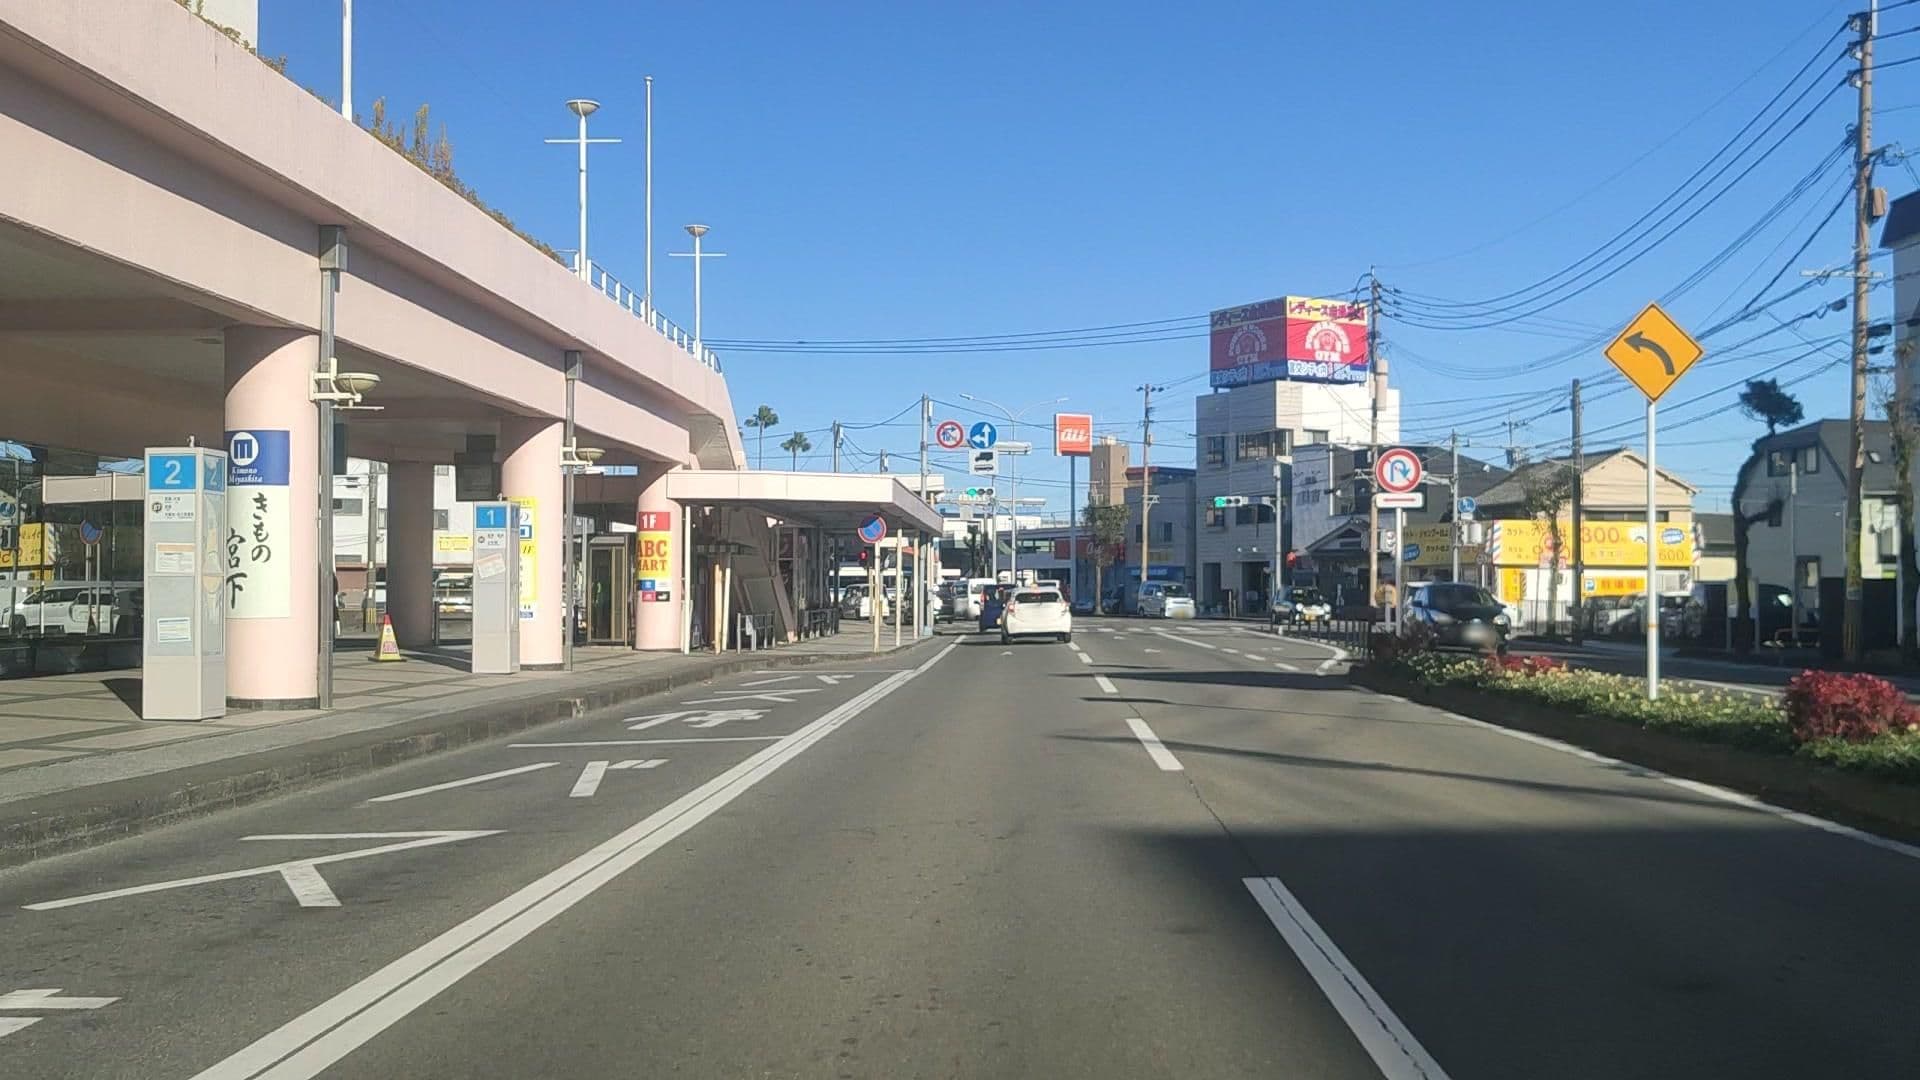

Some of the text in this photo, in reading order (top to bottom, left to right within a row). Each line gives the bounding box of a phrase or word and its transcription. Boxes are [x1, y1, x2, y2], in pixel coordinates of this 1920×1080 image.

[1060, 427, 1088, 443] au
[164, 460, 182, 485] 2
[486, 509, 495, 526] 1
[642, 513, 657, 529] 1F
[251, 492, 272, 563] きもの
[637, 540, 668, 558] ABC
[226, 528, 248, 610] 宮下
